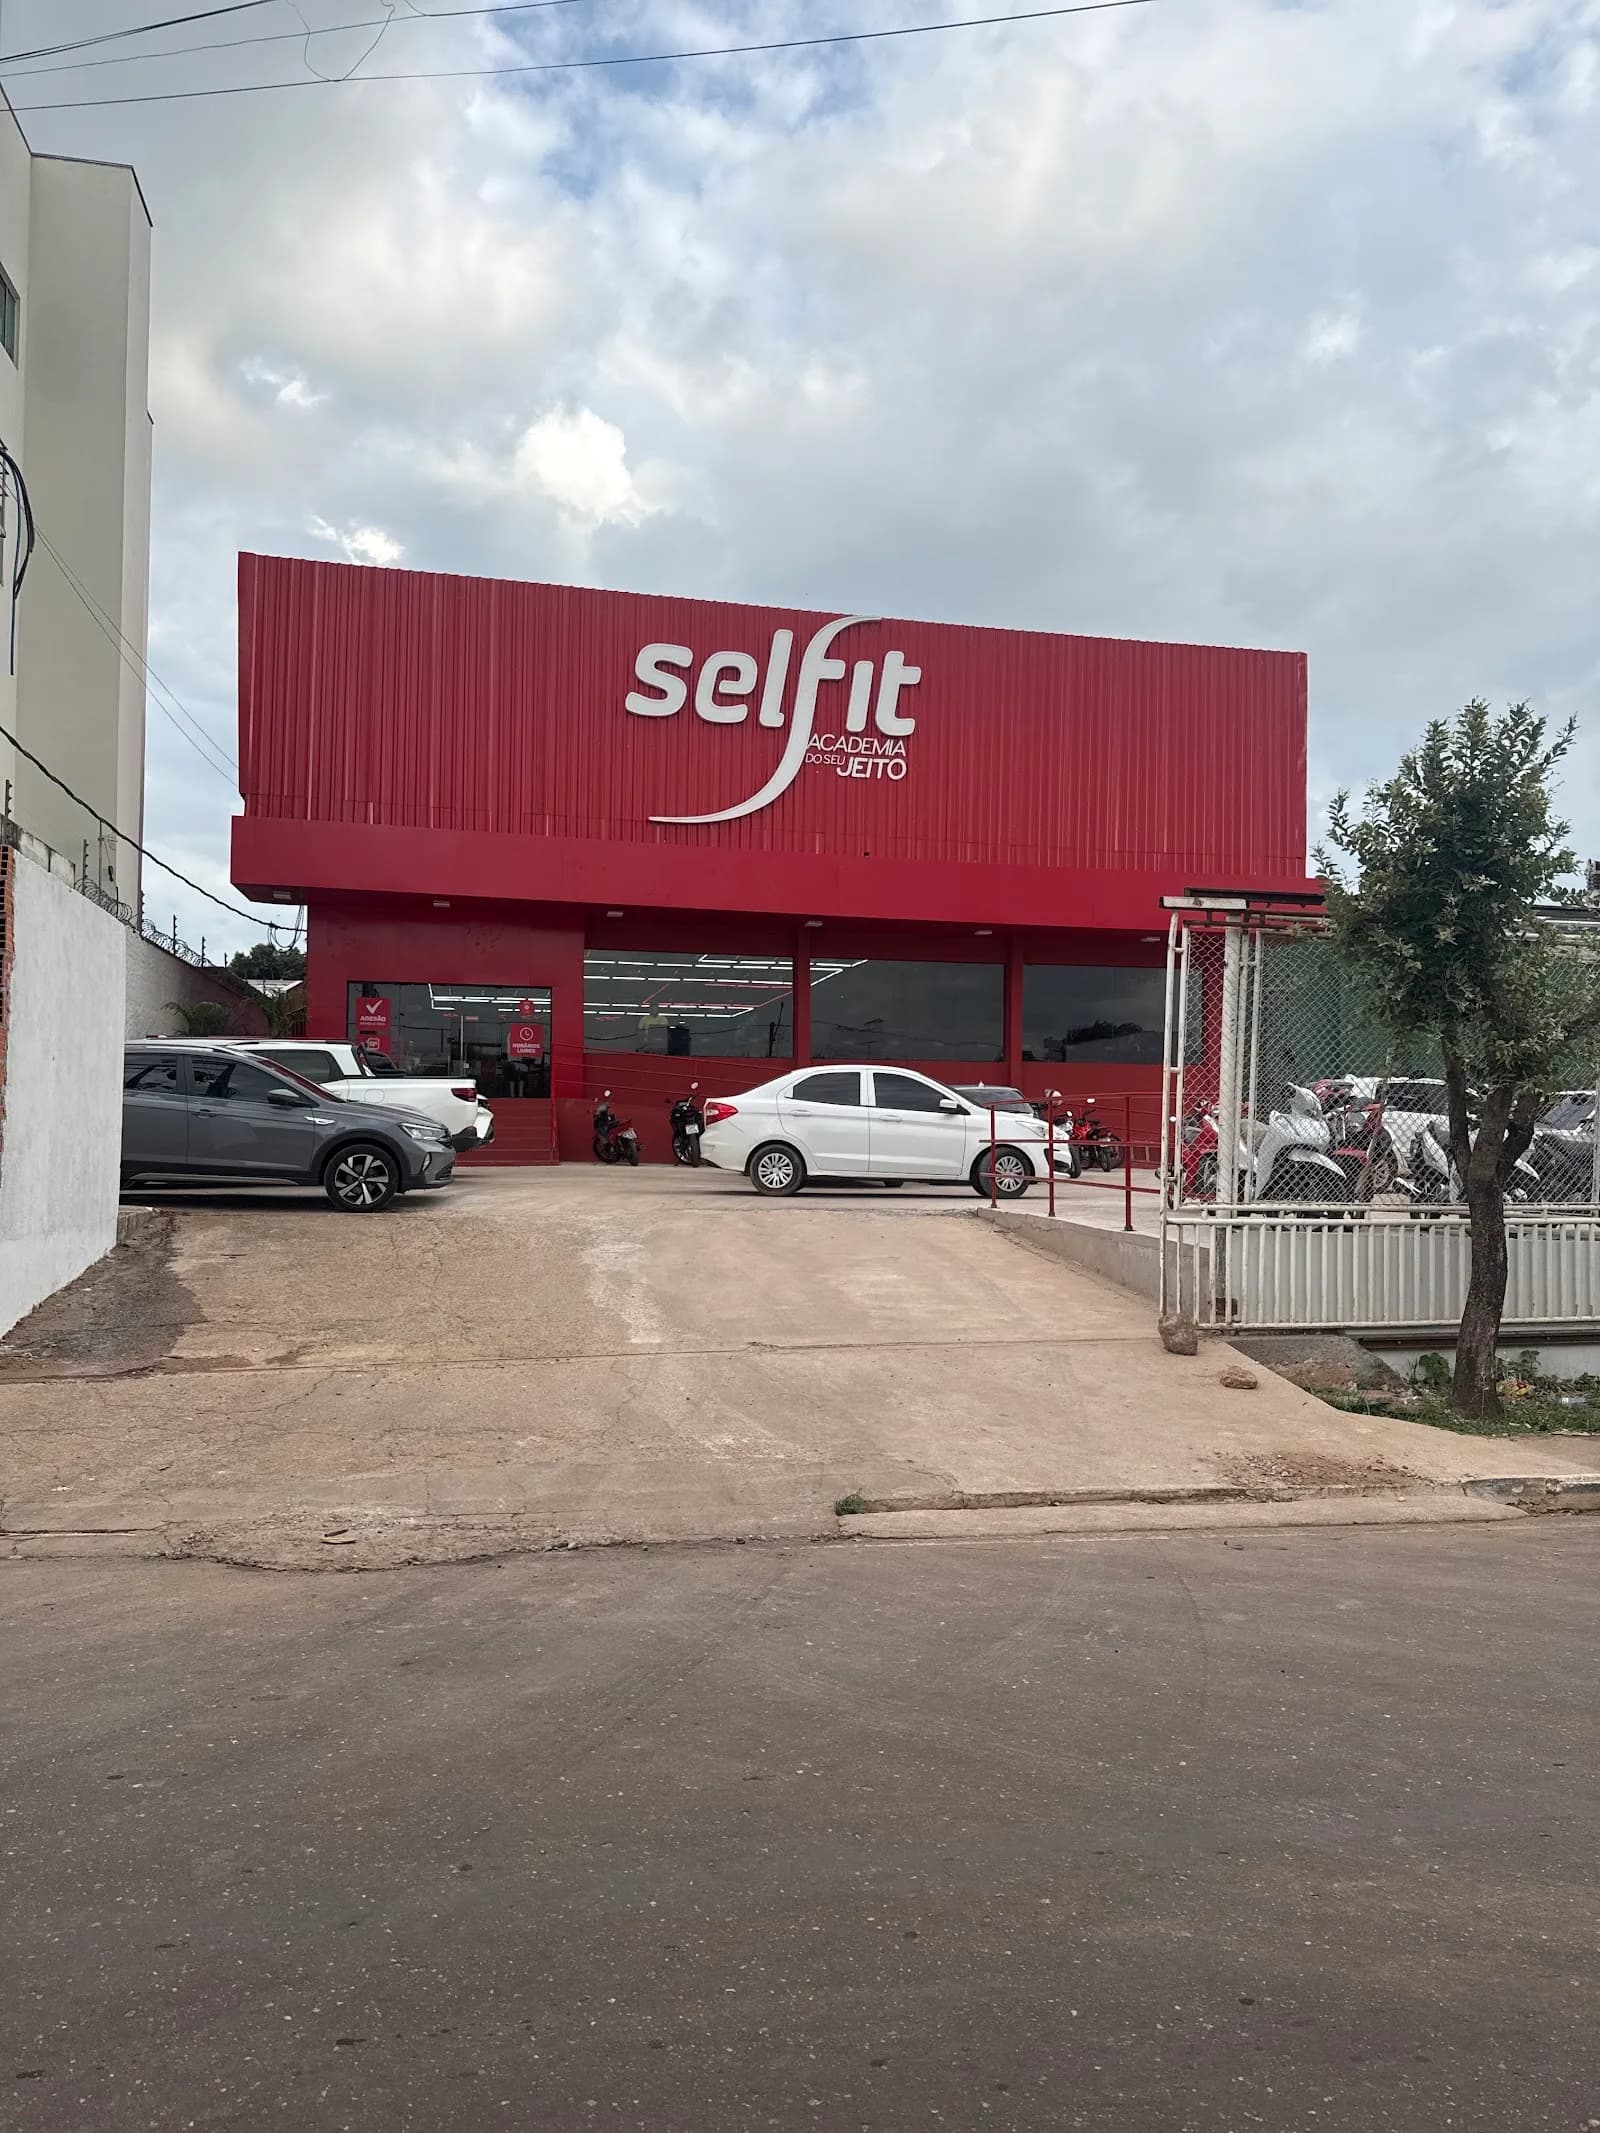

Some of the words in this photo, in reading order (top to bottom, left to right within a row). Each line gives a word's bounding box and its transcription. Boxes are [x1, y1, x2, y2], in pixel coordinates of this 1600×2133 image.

[625, 615, 921, 824] selfit
[807, 733, 906, 757] ACADEMIA
[805, 753, 823, 764] DO
[823, 755, 846, 766] SEU
[836, 757, 907, 780] JEITO
